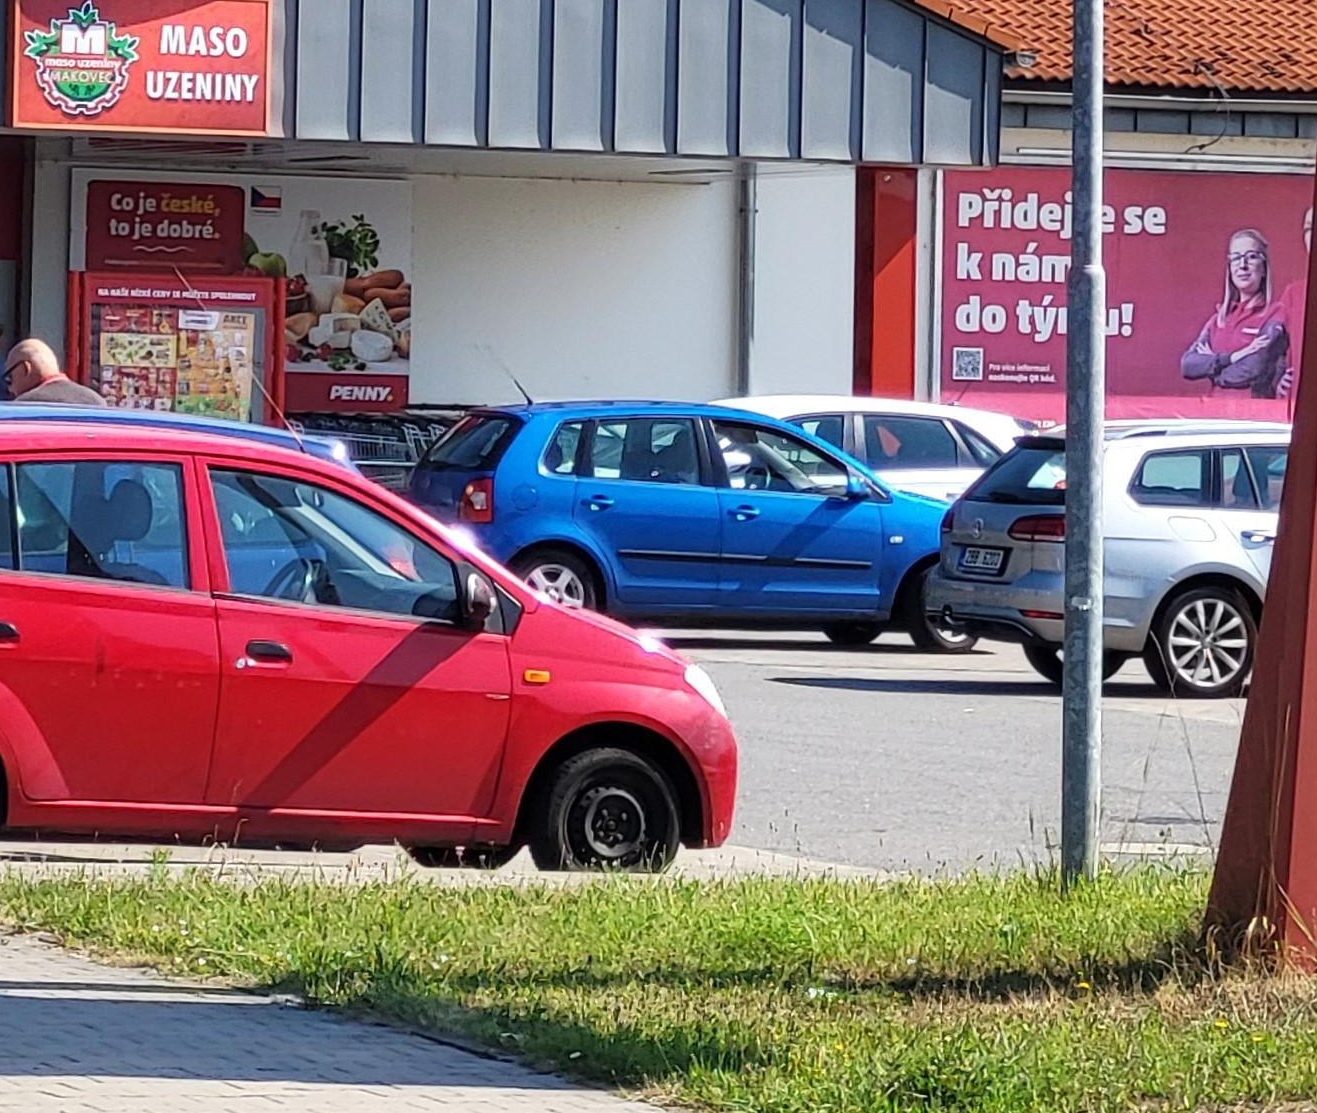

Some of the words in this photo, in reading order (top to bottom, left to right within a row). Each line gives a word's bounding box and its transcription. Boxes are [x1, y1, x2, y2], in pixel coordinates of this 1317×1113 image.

[61, 25, 106, 55] M
[160, 24, 247, 57] MASO
[45, 59, 75, 67] maso
[77, 58, 121, 68] uzeniny
[51, 71, 114, 83] MAKOVEC
[146, 70, 259, 102] UZENINY
[110, 193, 134, 210] Co
[137, 192, 157, 215] je
[161, 193, 220, 216] české,
[958, 188, 1116, 239] Přideje
[1123, 205, 1167, 234] se
[109, 218, 130, 236] to
[132, 217, 152, 240] je
[157, 219, 220, 239] dobré.
[956, 242, 983, 280] k
[991, 242, 1072, 283] nám
[955, 295, 1007, 333] do
[1016, 295, 1134, 342] týu!
